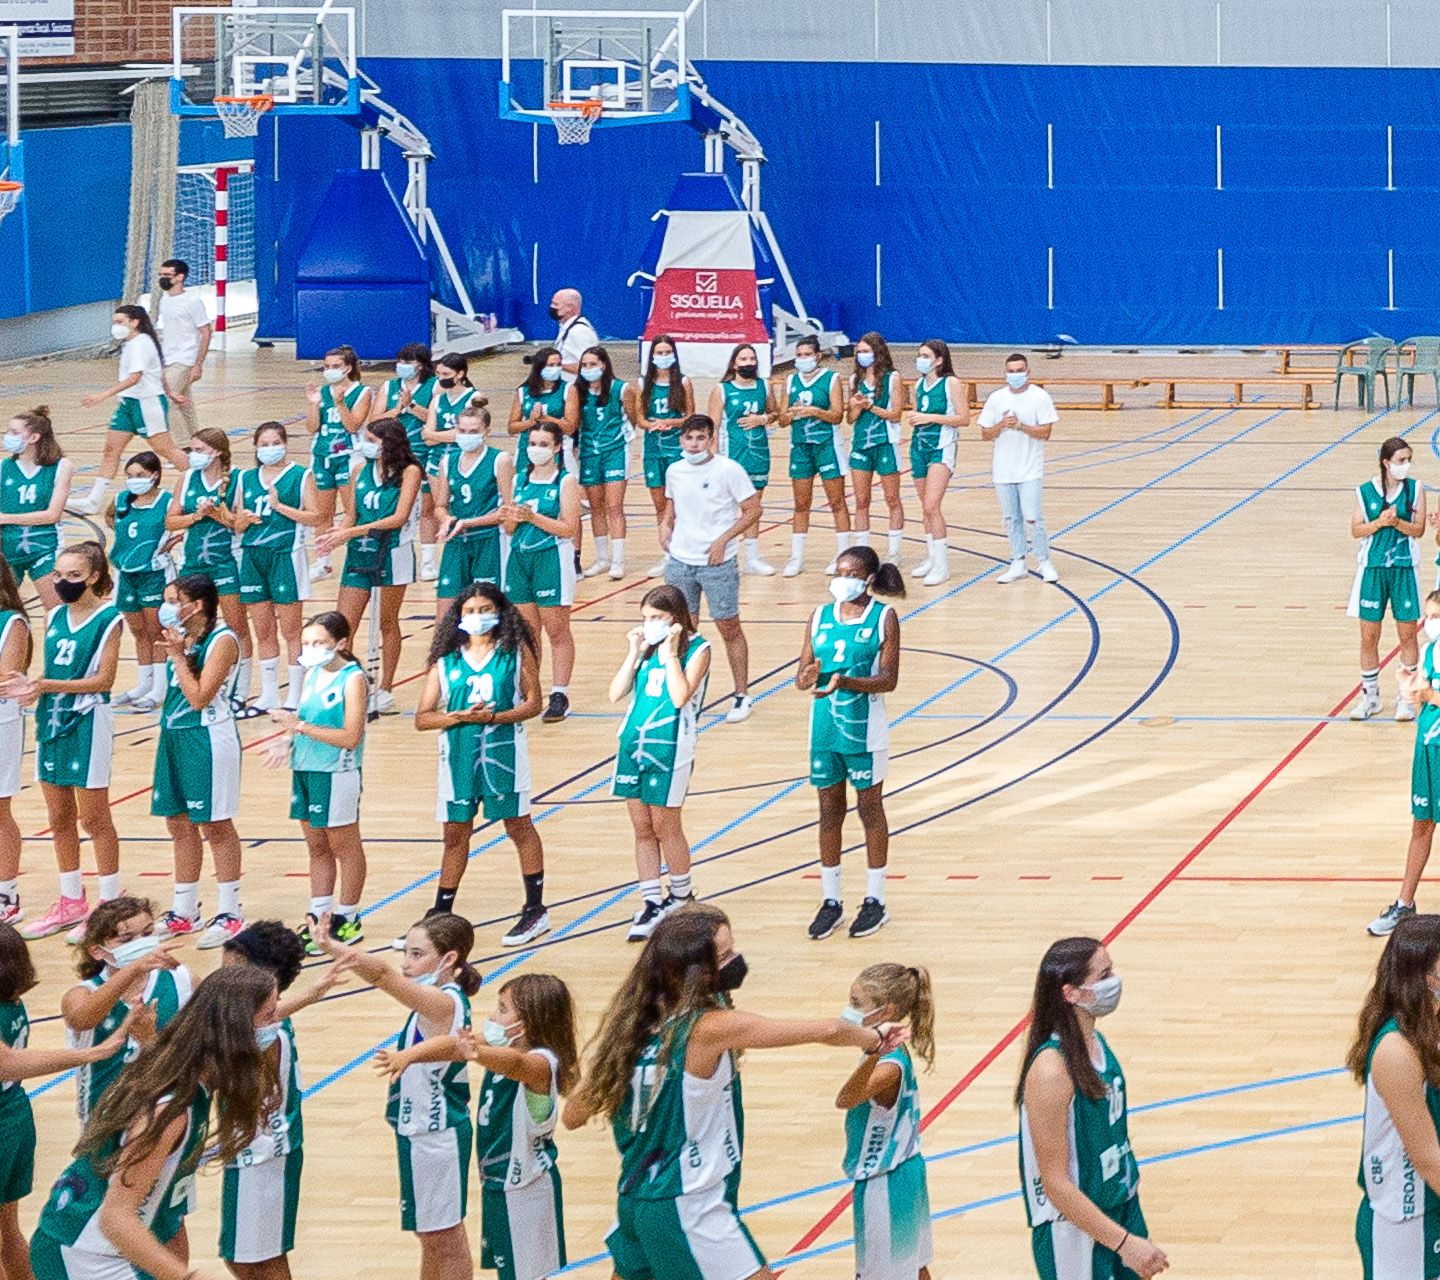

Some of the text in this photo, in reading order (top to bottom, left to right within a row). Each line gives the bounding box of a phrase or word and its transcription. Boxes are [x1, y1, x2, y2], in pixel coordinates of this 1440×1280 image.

[670, 294, 743, 308] SISQUELLA
[597, 407, 604, 421] 5
[655, 398, 668, 413] 12
[18, 484, 36, 503] 14
[461, 484, 471, 503] 9
[255, 494, 273, 516] 12
[128, 522, 137, 538] 6
[54, 639, 76, 665] 23
[833, 640, 846, 662] 2
[400, 1098, 413, 1125] CBF
[689, 1139, 701, 1169] CBF
[510, 1157, 523, 1184] CBF
[1372, 1156, 1384, 1184] CBF
